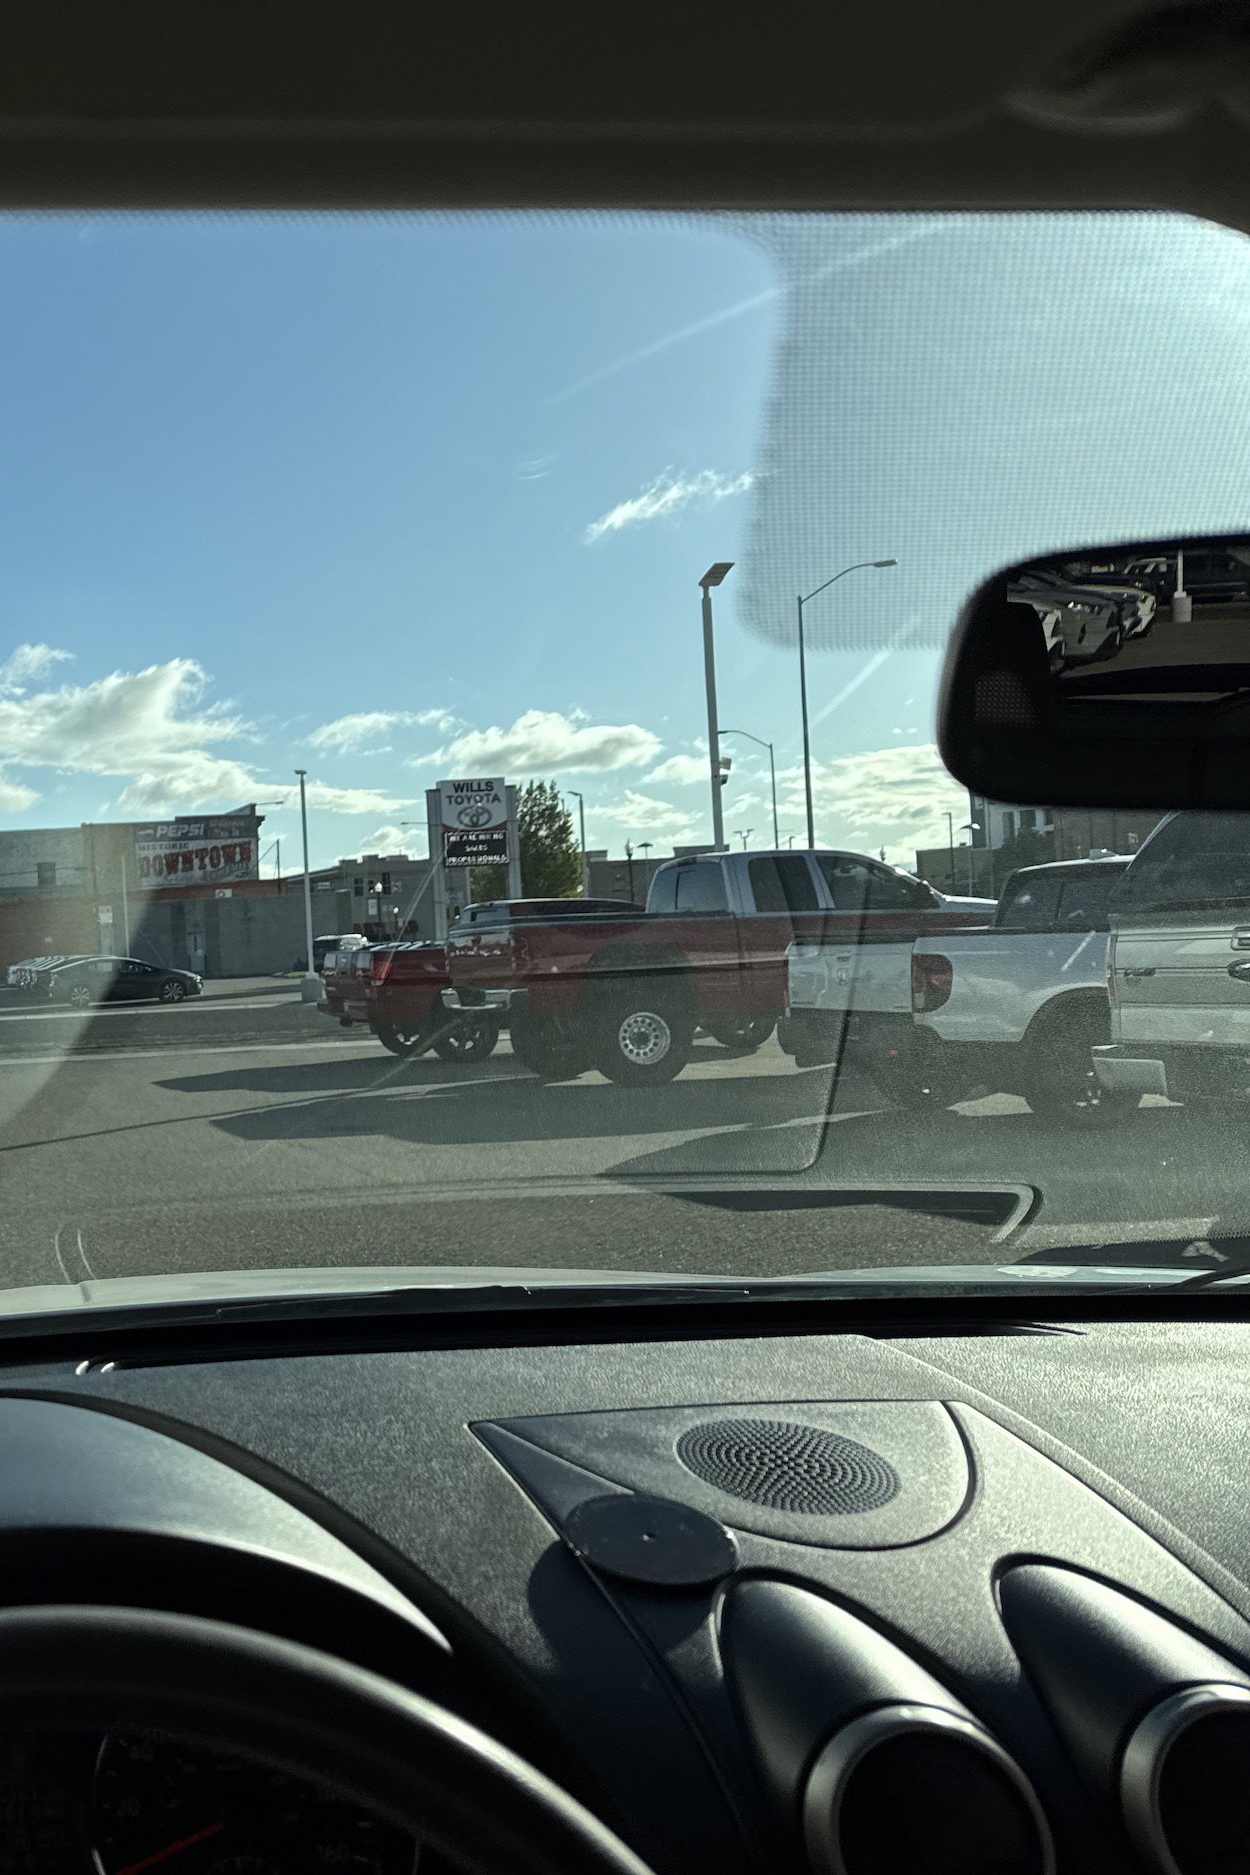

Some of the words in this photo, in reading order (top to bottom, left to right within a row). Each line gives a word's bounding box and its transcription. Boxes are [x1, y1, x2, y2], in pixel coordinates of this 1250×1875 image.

[453, 781, 494, 793] WILLS
[446, 793, 501, 805] TOYOTA
[157, 824, 204, 838] PEPSI
[139, 842, 190, 851] HISTORIC
[140, 841, 251, 878] DOWNTOWN
